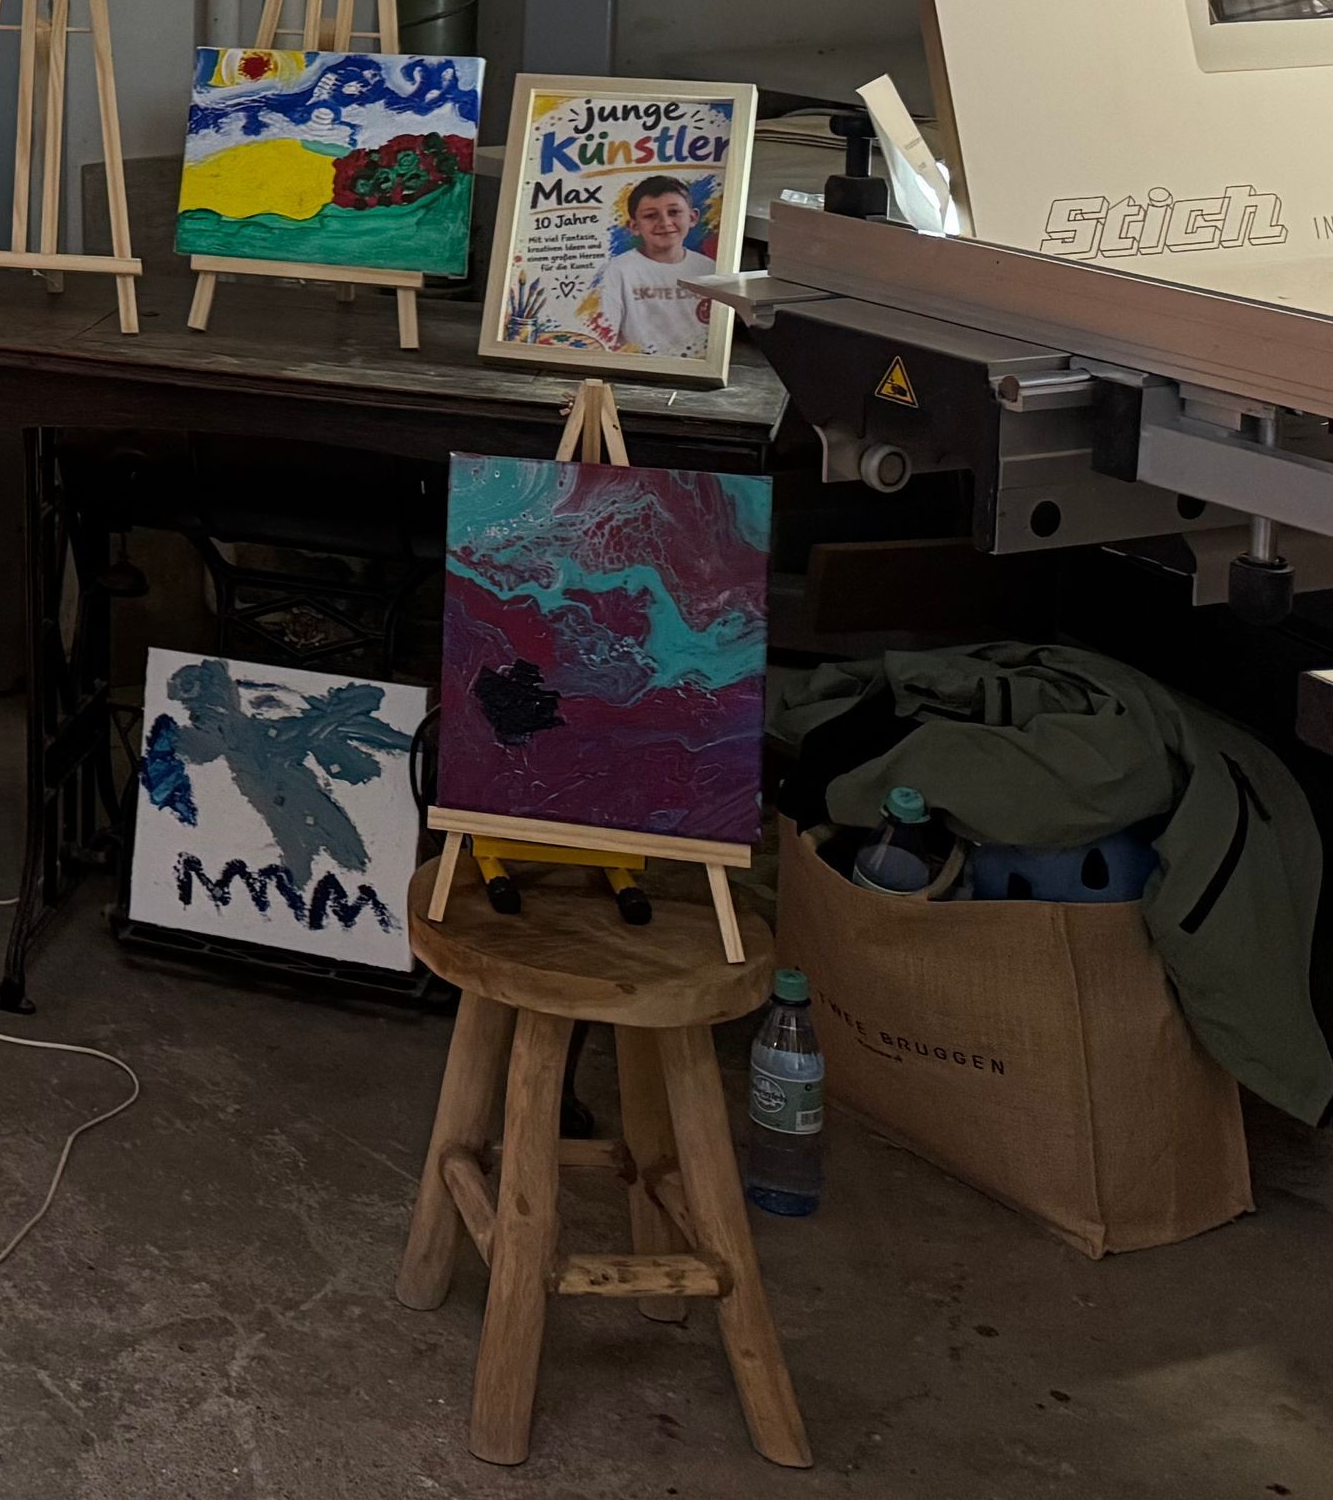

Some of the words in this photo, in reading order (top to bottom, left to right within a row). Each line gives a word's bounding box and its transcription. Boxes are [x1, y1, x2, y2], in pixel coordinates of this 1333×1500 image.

[572, 98, 688, 135] junge
[540, 125, 730, 175] Künstler
[530, 178, 604, 210] Max
[534, 216, 552, 231] 10
[554, 212, 599, 229] Jahre
[1039, 184, 1289, 261] Stich
[878, 1030, 1006, 1076] BRUGGEN
